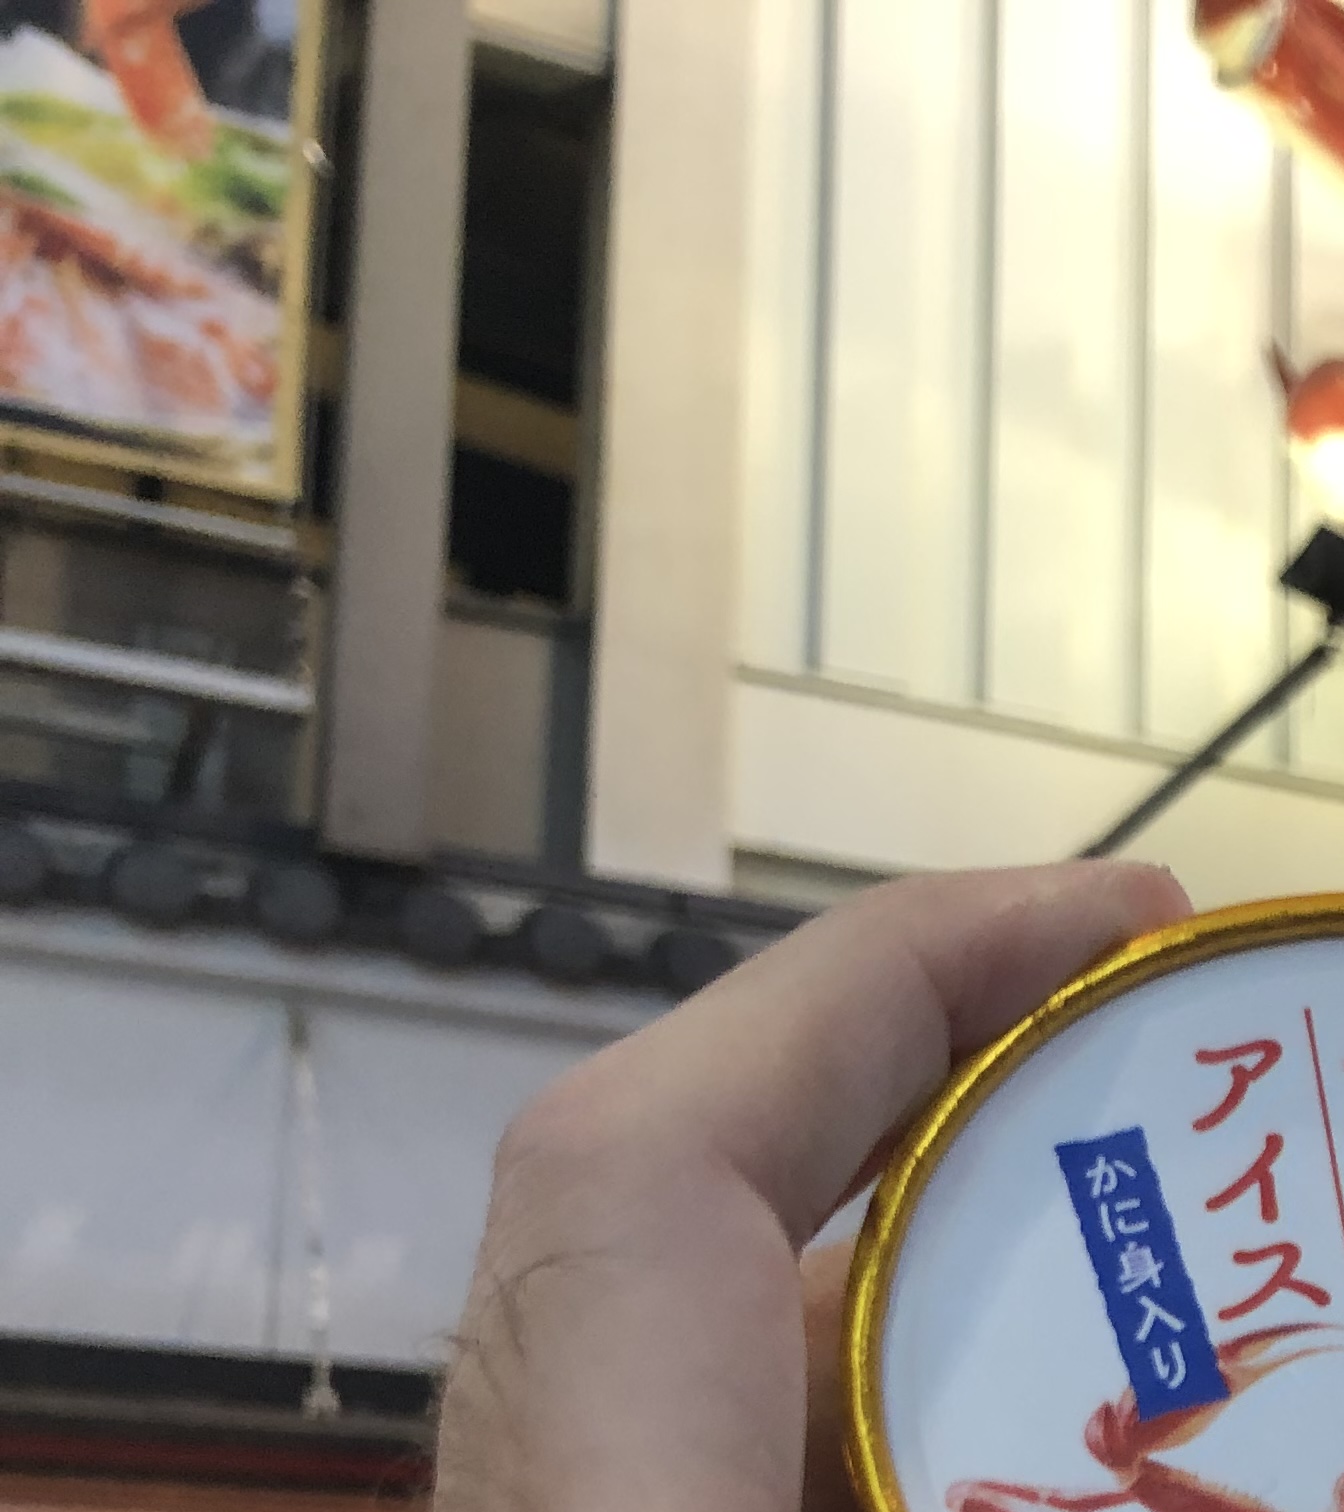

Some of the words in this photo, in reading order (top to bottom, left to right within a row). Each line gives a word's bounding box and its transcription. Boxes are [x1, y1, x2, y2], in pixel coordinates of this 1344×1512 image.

[1085, 1155, 1188, 1390] かに身入り
[1192, 1038, 1332, 1322] アイス
